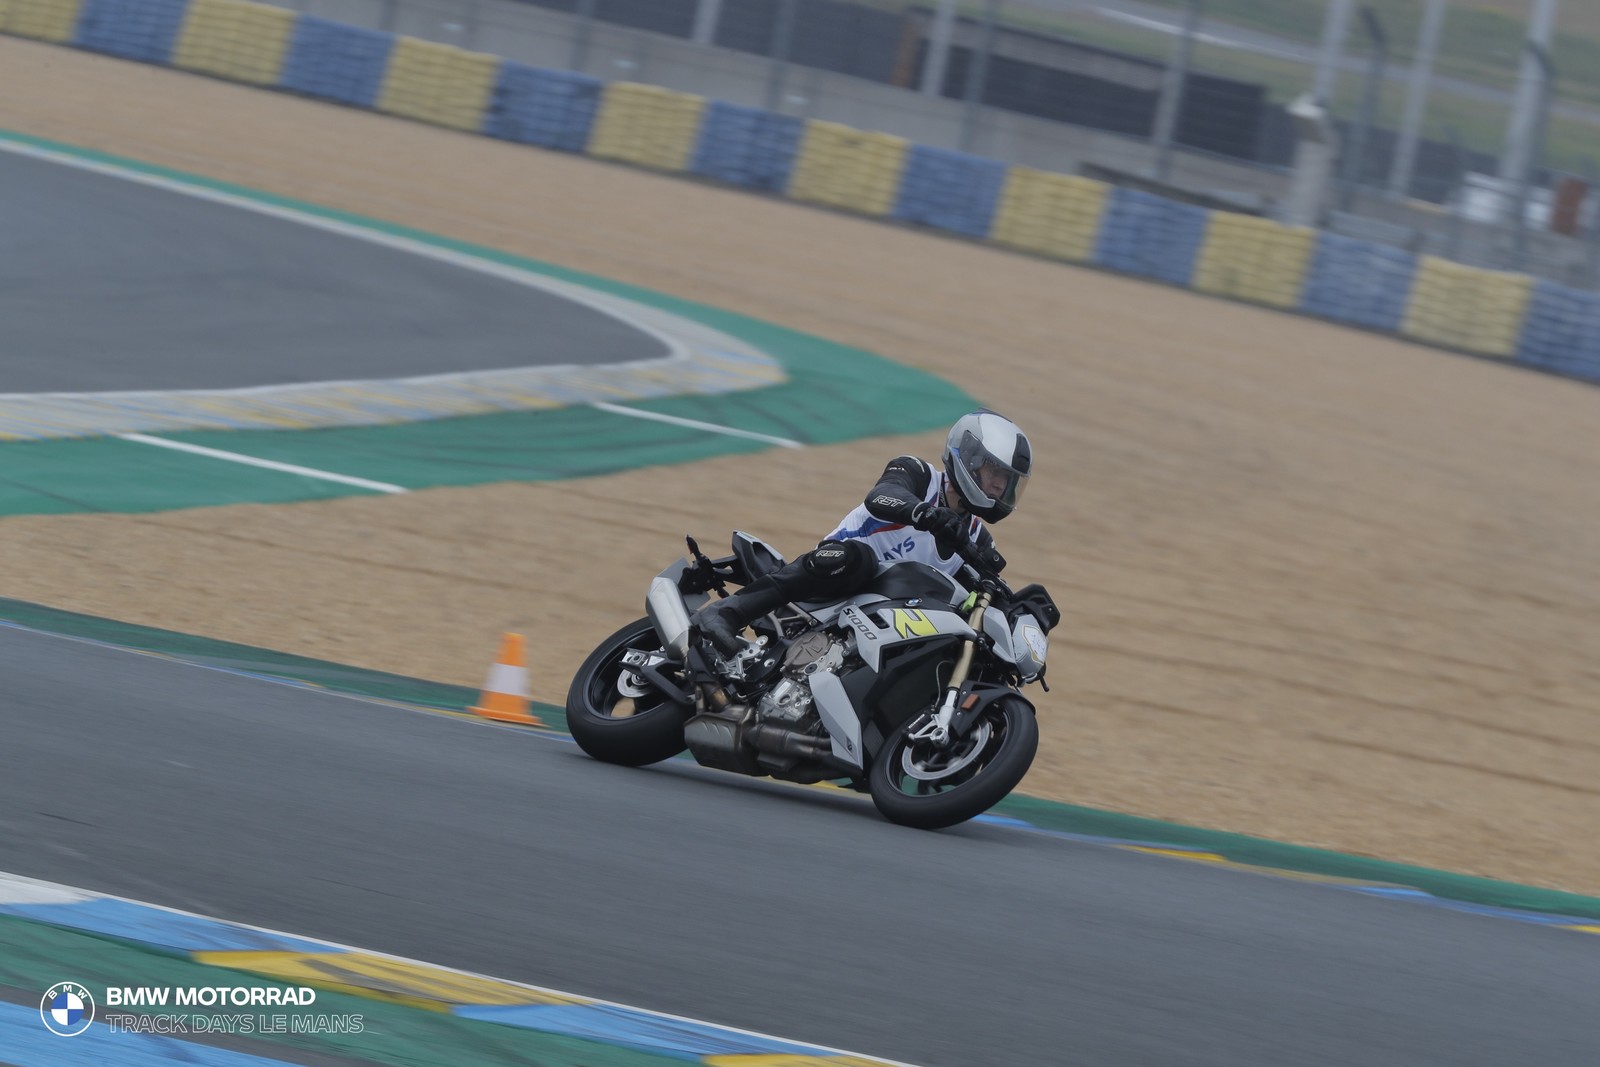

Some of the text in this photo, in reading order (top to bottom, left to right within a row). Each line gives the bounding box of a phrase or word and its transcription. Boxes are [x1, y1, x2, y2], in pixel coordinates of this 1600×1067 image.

[872, 494, 907, 508] RST
[815, 549, 845, 558] RST
[879, 535, 916, 561] AYS
[843, 608, 878, 641] S1000
